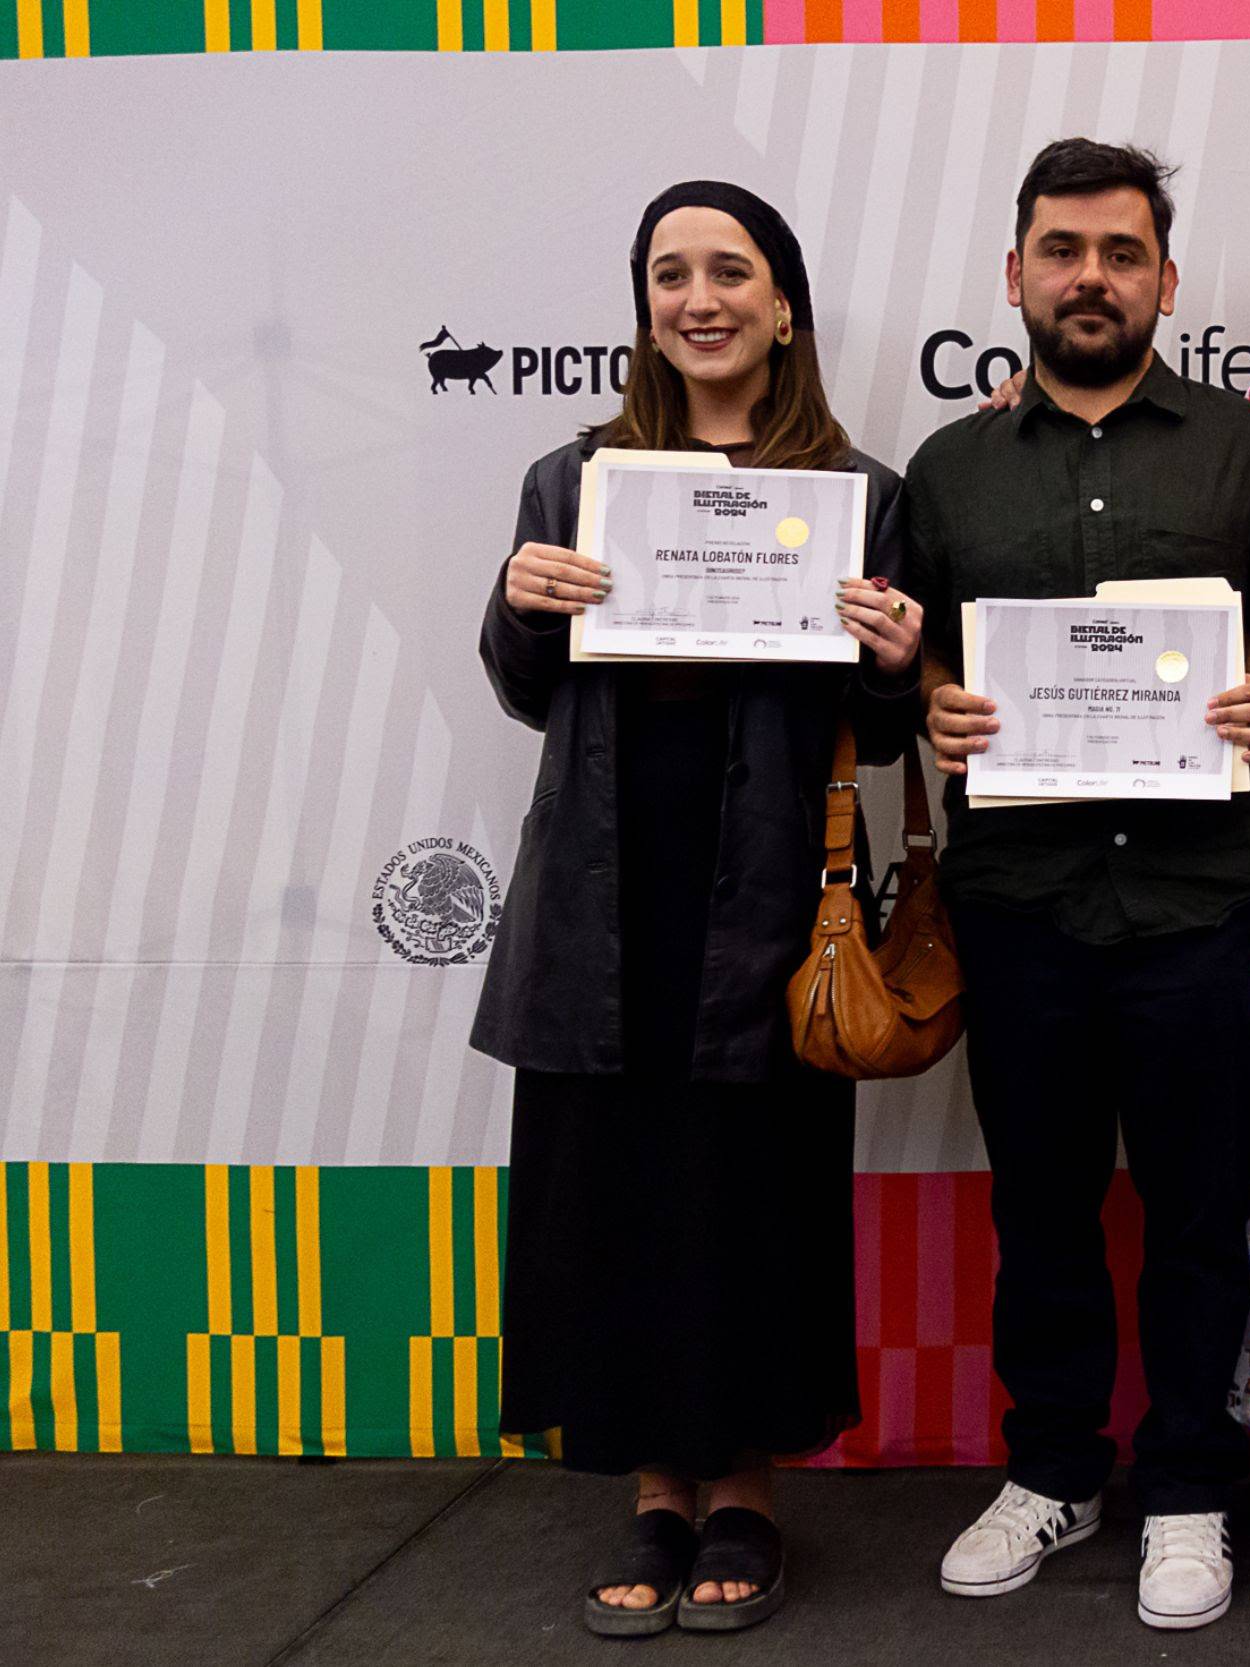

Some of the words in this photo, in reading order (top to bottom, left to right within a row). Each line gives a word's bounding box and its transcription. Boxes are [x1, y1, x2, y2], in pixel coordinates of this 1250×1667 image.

[513, 345, 634, 395] PICTO
[736, 491, 751, 500] DE
[714, 509, 747, 517] 2024
[655, 549, 699, 562] RENATA
[702, 549, 753, 564] LOBATÓN
[756, 552, 799, 565] FLORES
[1112, 626, 1126, 634] DE
[1091, 644, 1123, 652] 2024
[1029, 685, 1065, 701] JESÚS
[1068, 686, 1128, 702] GUTIÉRREZ
[1132, 689, 1181, 702] MIRANDA
[372, 850, 407, 900] ESTADOS
[408, 837, 453, 855] UNIDOS
[456, 841, 500, 900] MEXICANOS
